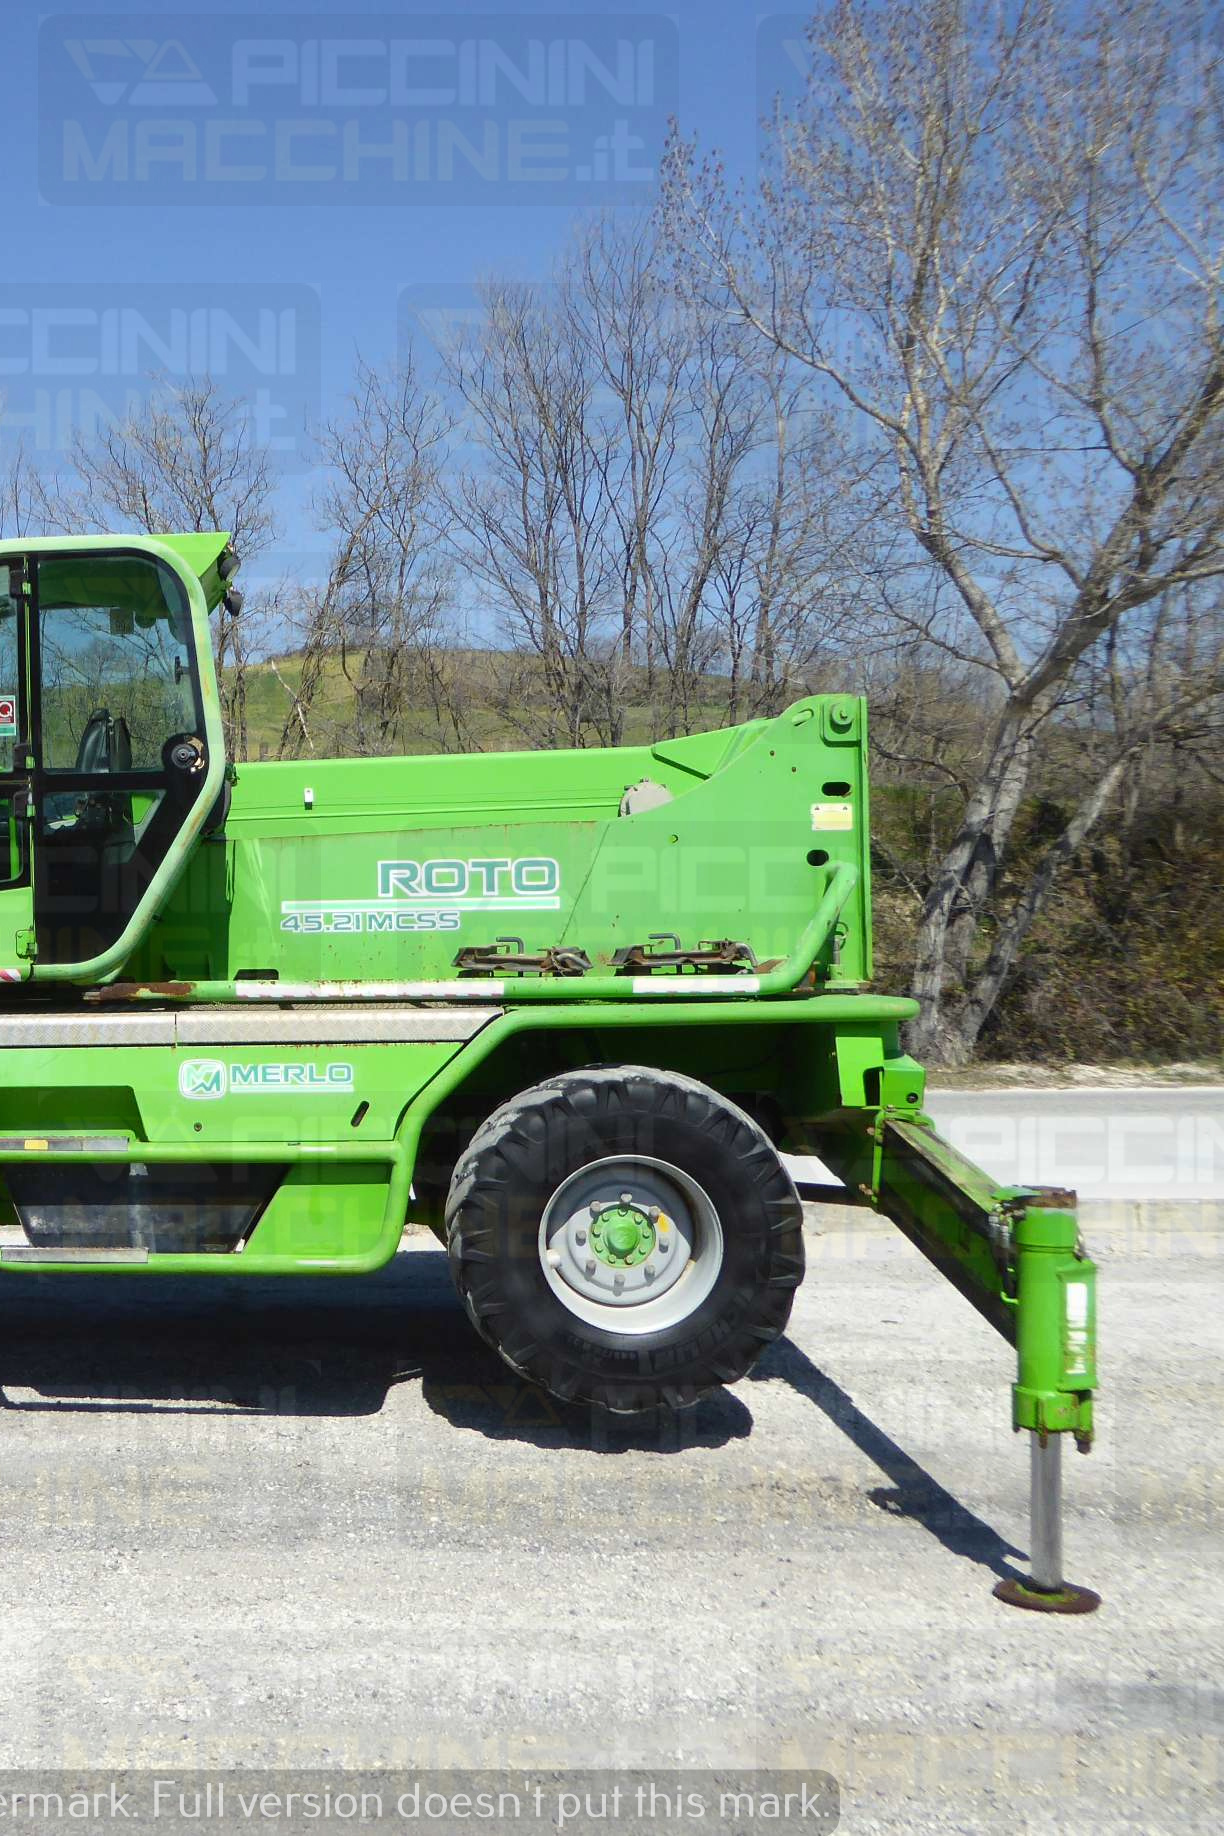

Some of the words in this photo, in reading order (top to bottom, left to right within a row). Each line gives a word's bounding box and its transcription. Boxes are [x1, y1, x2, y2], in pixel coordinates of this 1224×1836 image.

[377, 859, 559, 896] ROTO
[366, 910, 460, 931] MCSS
[230, 1064, 352, 1083] MERLO
